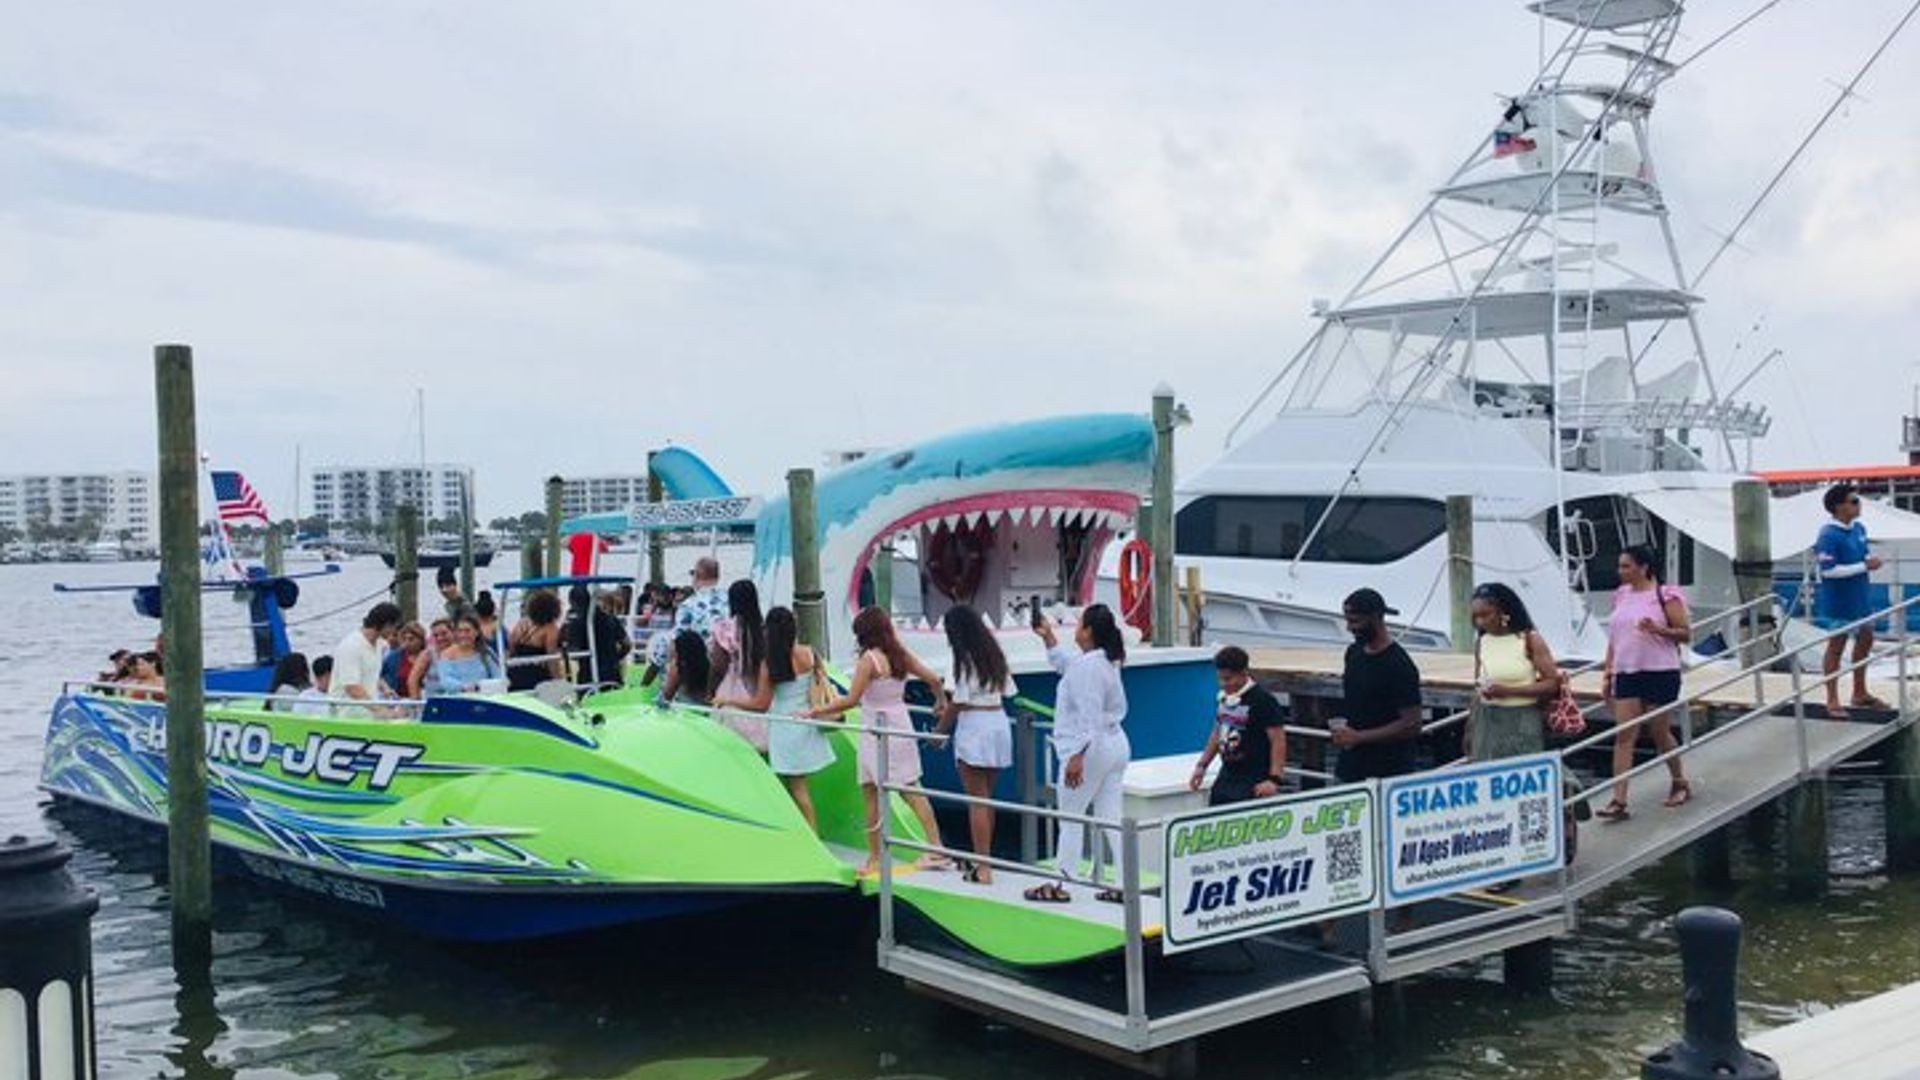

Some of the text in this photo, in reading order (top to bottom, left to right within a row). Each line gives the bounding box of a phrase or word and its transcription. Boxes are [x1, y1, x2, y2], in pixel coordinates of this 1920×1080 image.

[279, 731, 426, 791] JET
[1397, 769, 1549, 818] SHARK BOAT
[1174, 797, 1367, 858] HYDRO JET
[1398, 841, 1417, 868] All
[1419, 838, 1449, 866] Ages
[1451, 823, 1513, 858] Welcome!
[1183, 873, 1240, 915] Jet
[1245, 858, 1314, 902] Ski!
[1217, 860, 1235, 872] The
[1197, 900, 1301, 931] hydrojetboats.com
